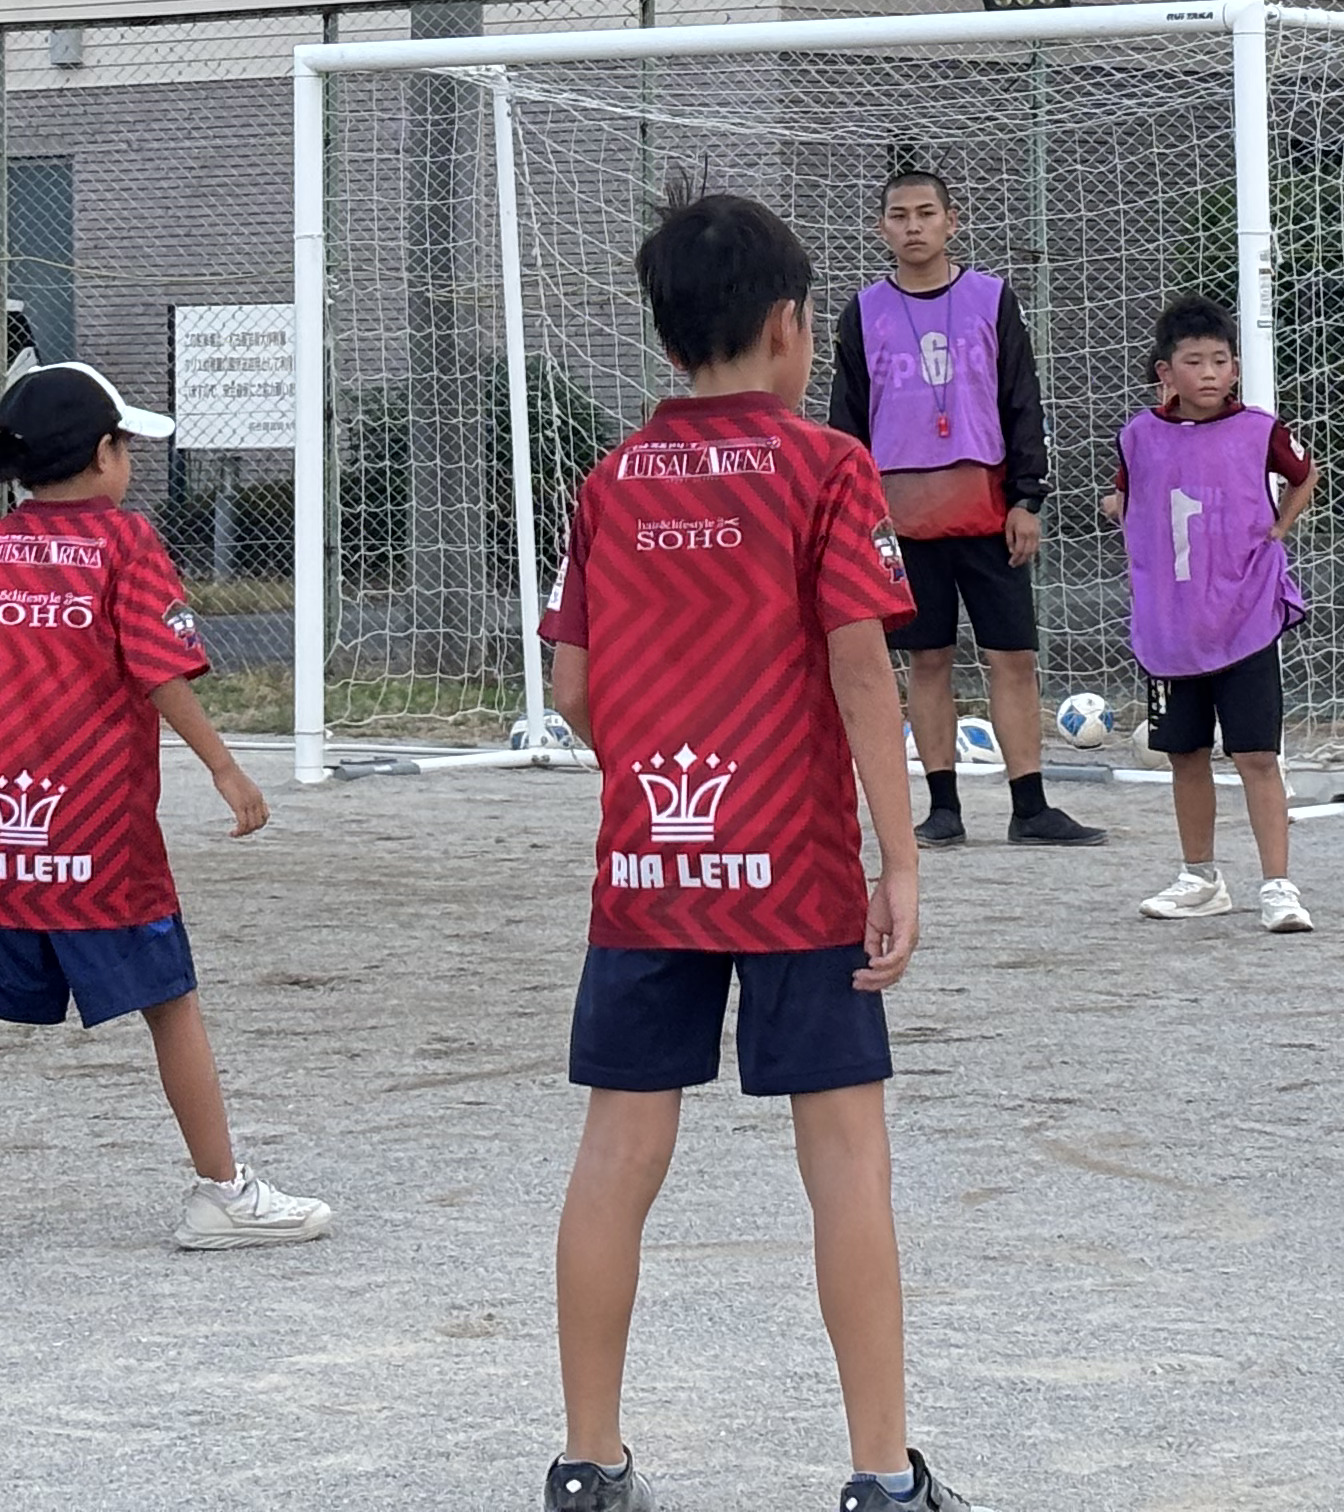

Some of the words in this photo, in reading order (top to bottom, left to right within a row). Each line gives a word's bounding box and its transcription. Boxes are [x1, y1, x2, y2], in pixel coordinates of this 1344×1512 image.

[920, 331, 953, 385] 6
[636, 527, 742, 551] SOHO
[16, 854, 92, 883] LETO
[611, 850, 665, 889] RIA
[676, 853, 772, 890] LETO
